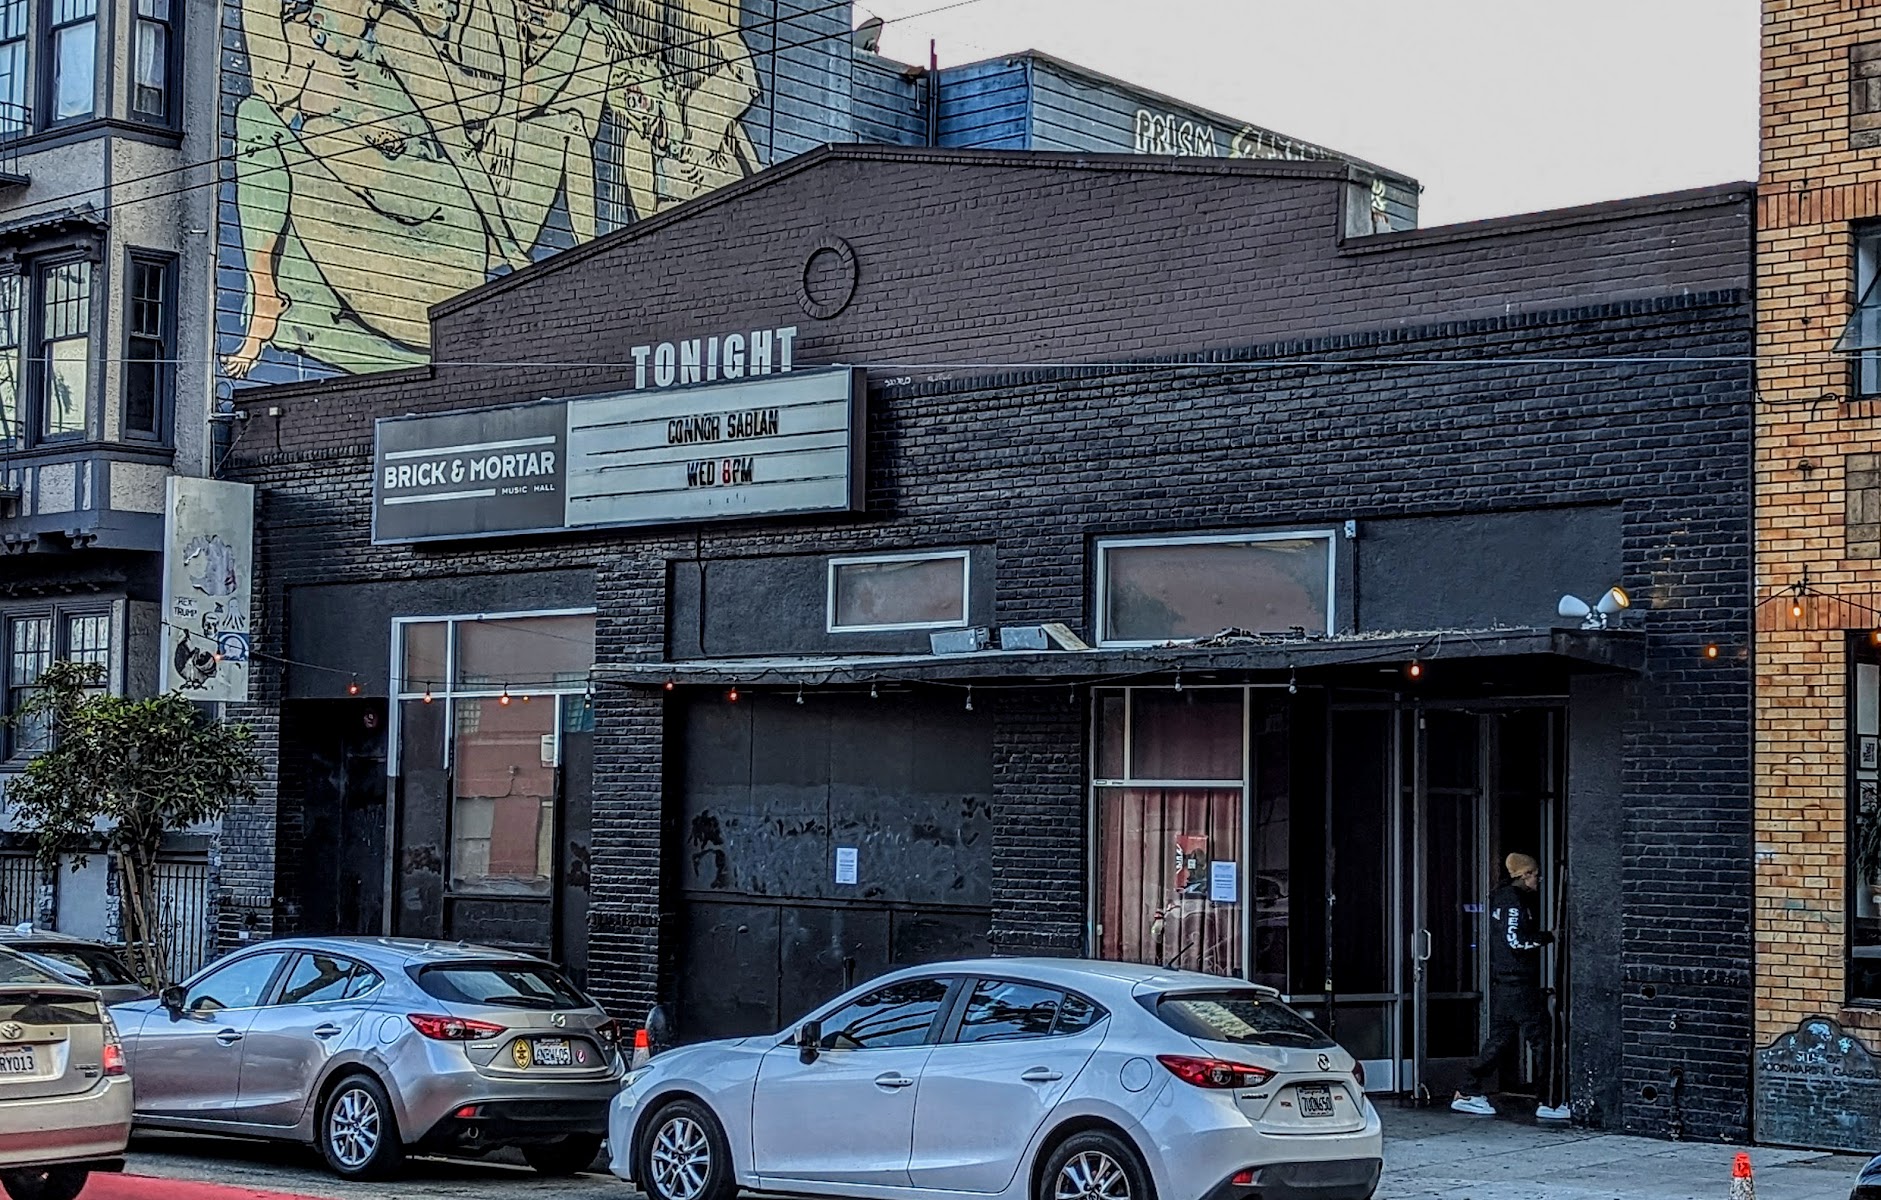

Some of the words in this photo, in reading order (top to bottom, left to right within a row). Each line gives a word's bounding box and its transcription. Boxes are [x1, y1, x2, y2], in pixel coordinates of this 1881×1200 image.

[1134, 109, 1218, 158] PRISM
[631, 326, 797, 389] TONIGHT
[668, 416, 720, 444] CONNOR
[727, 409, 779, 438] SABLAN
[384, 461, 447, 489] BRICK
[451, 459, 465, 483] &
[470, 451, 556, 482] MORTAR
[687, 461, 715, 487] WED
[722, 457, 754, 484] 8PM
[502, 486, 528, 495] MUSIC
[534, 484, 555, 492] HALL
[174, 606, 198, 617] TRUMP
